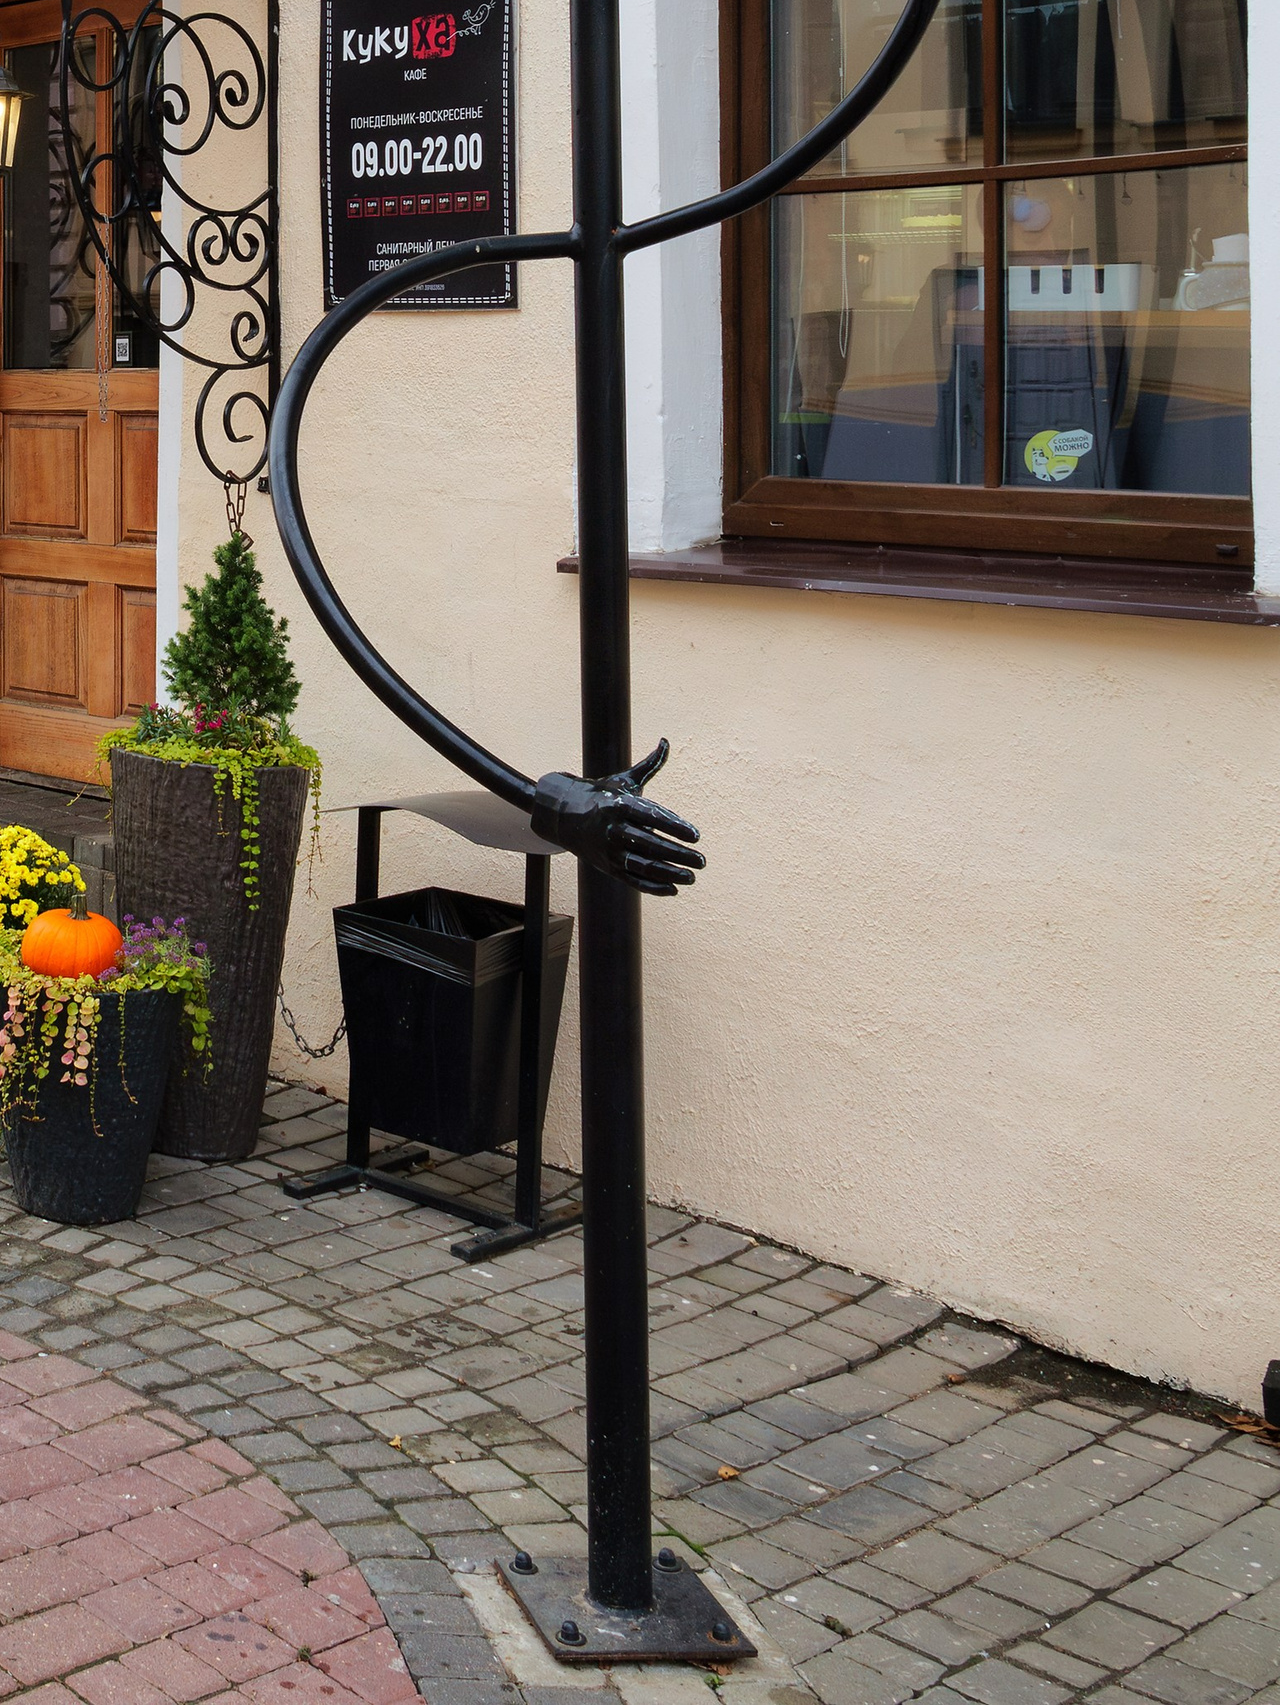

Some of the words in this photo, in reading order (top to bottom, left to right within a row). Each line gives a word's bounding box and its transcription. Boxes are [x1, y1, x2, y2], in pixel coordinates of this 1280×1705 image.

[403, 68, 427, 81] КАФЕ
[350, 106, 483, 129] ПОНЕДЕЛЬНИК-ВОСКРЕСЕНЬЕ
[351, 132, 483, 178] 09.00-22.00
[376, 239, 433, 255] САНИТАРНЫЙ
[1058, 435, 1089, 444] СОБАКОЙ
[1054, 442, 1090, 452] МОЖНО
